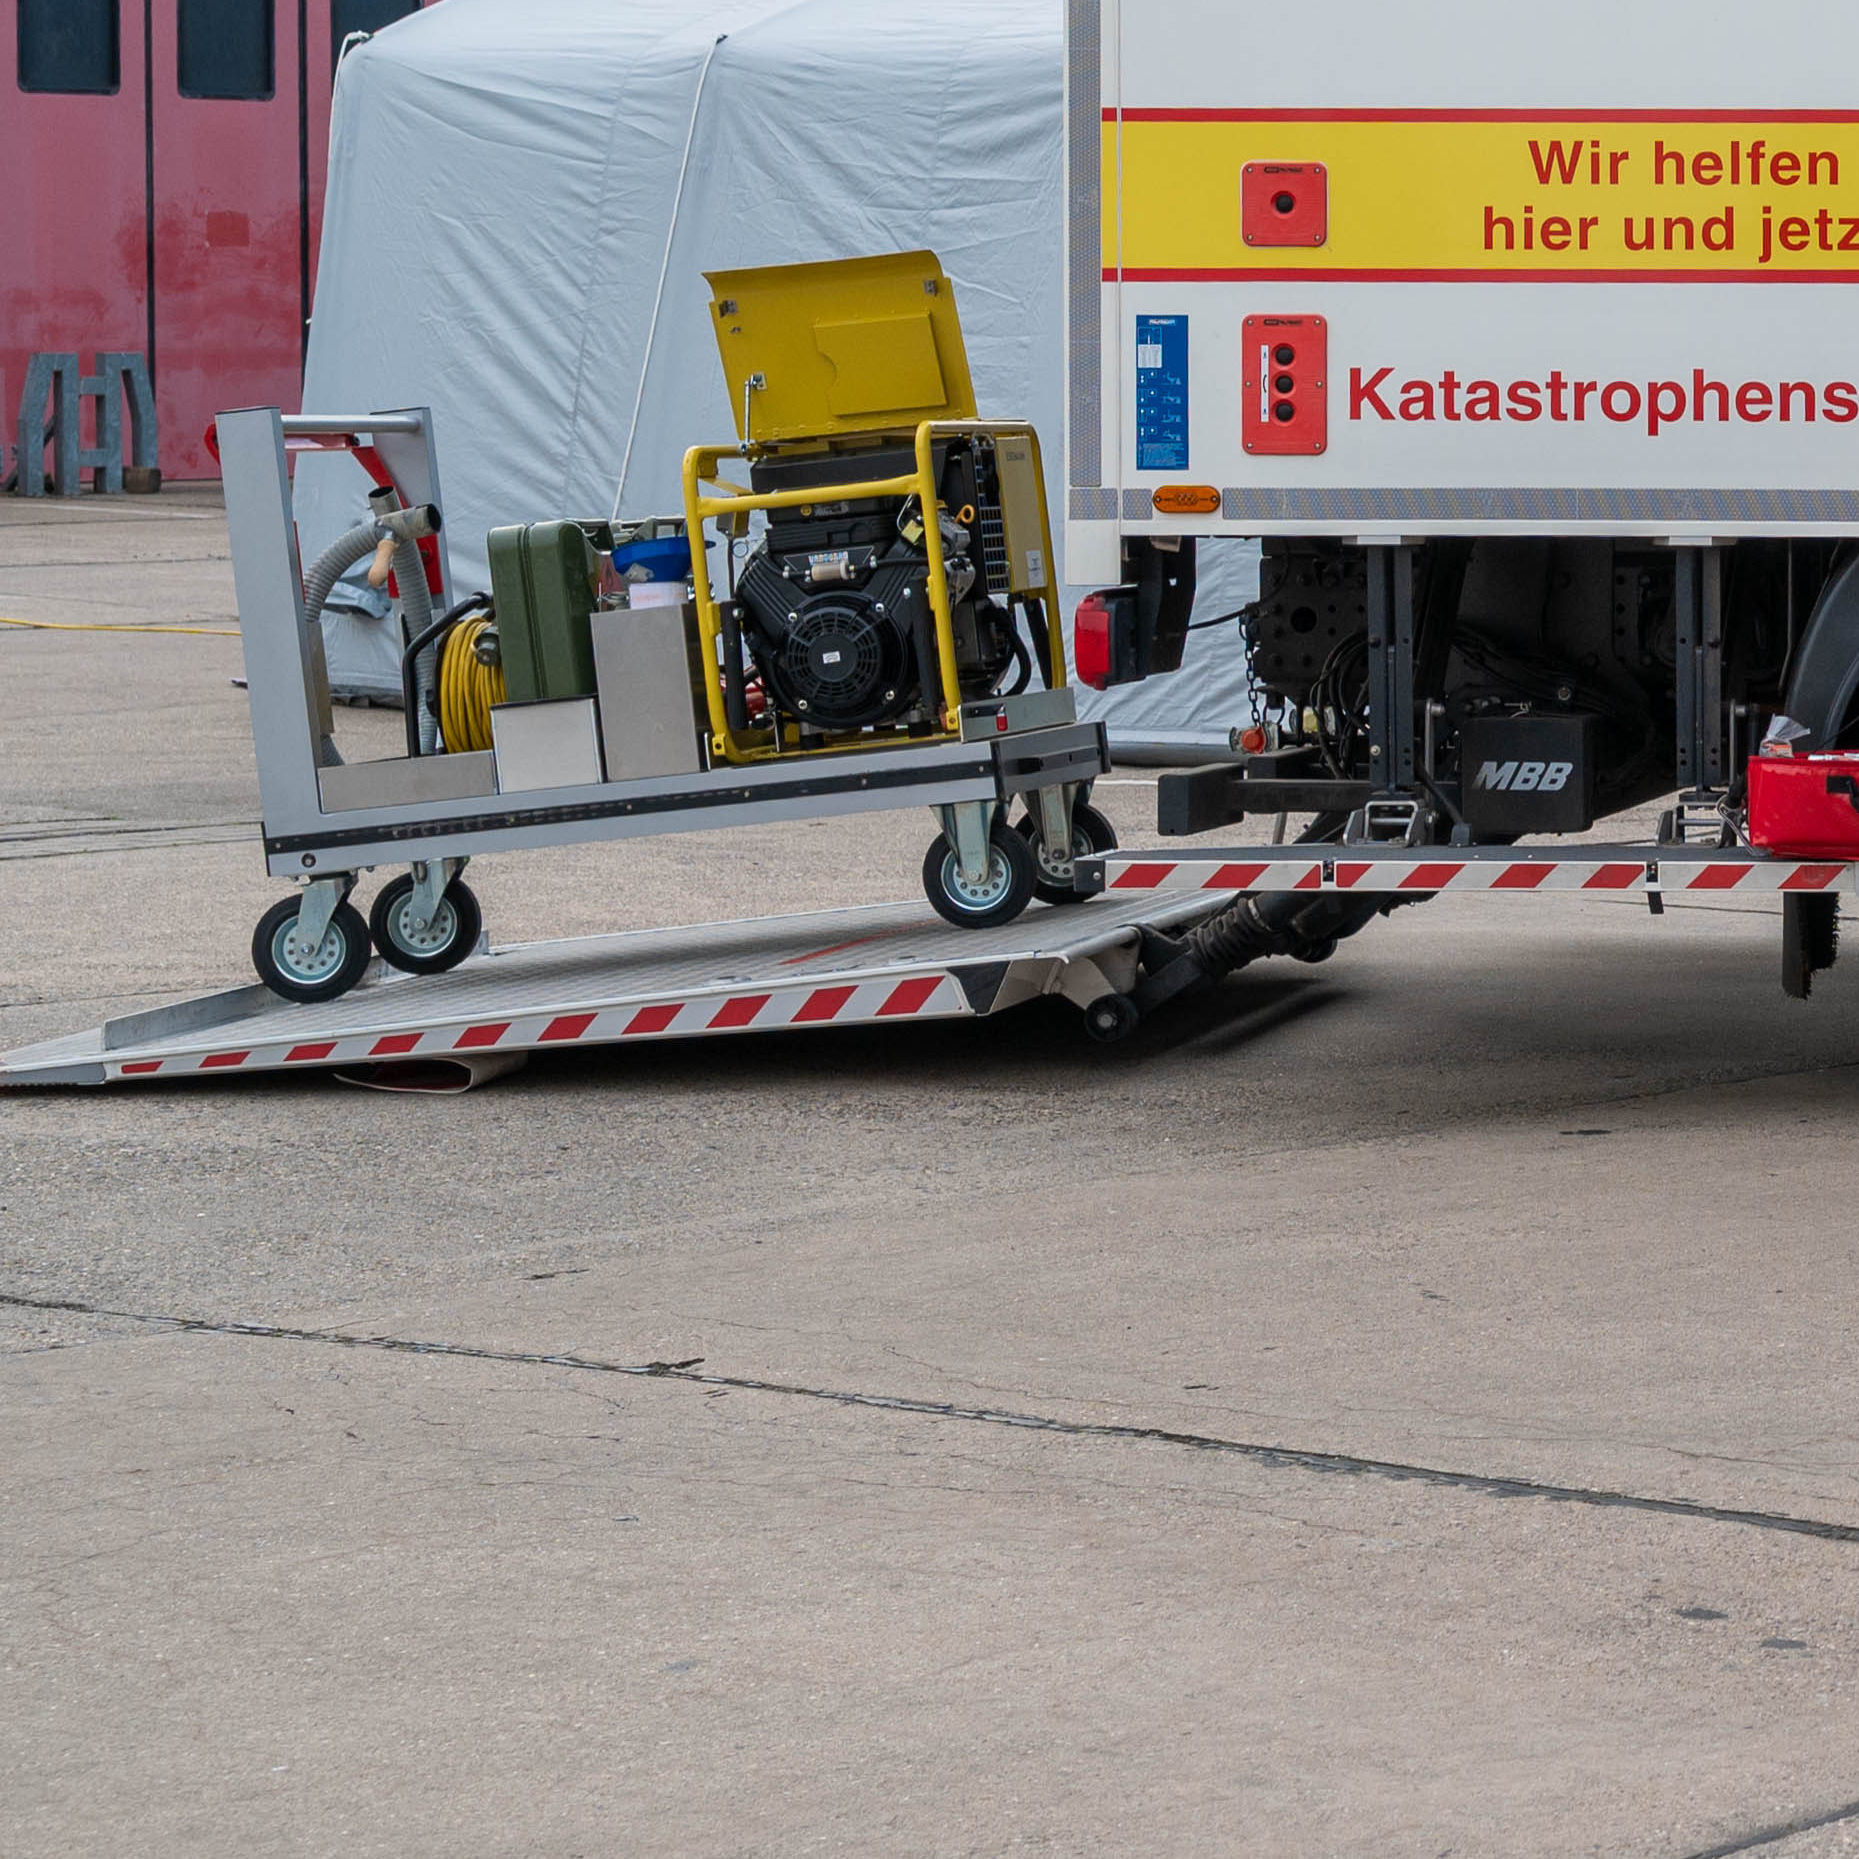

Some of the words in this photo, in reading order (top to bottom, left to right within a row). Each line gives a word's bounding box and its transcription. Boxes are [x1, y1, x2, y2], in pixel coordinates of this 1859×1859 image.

[1528, 140, 1629, 185] Wir
[1654, 140, 1840, 186] helfen
[1483, 205, 1599, 251] hier
[1623, 206, 1735, 252] und
[1471, 761, 1574, 791] MBB
